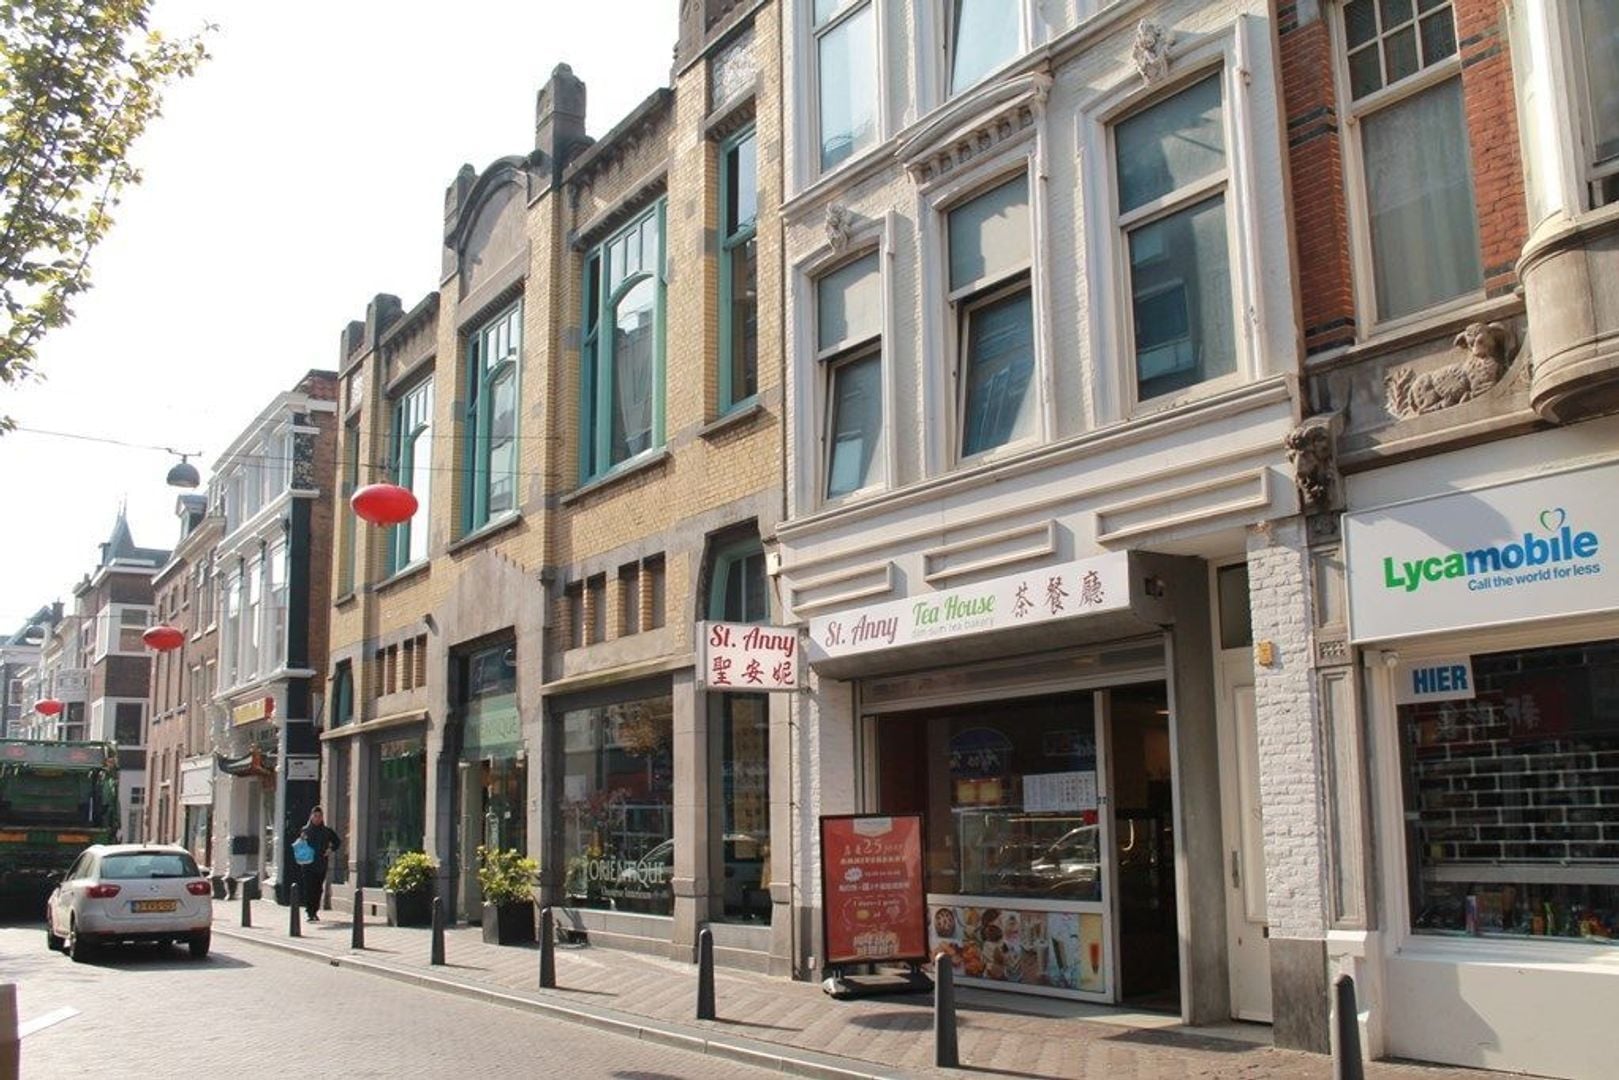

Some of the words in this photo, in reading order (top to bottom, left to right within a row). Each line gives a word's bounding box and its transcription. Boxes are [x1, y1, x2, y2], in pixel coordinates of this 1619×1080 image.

[1383, 526, 1599, 592] Lycamobile
[1467, 578, 1492, 592] Call
[1493, 575, 1514, 588] the
[1515, 571, 1551, 586] world
[1553, 567, 1571, 580] for
[1573, 563, 1600, 577] less
[912, 602, 940, 626] Tea
[944, 594, 996, 620] House
[1010, 570, 1106, 619] 茶餐廳
[709, 625, 738, 649] St.
[743, 627, 796, 658] Anny
[824, 620, 847, 649] St.
[850, 613, 899, 648] Anny
[711, 654, 796, 687] 聖安妮
[1413, 665, 1468, 694] HIER
